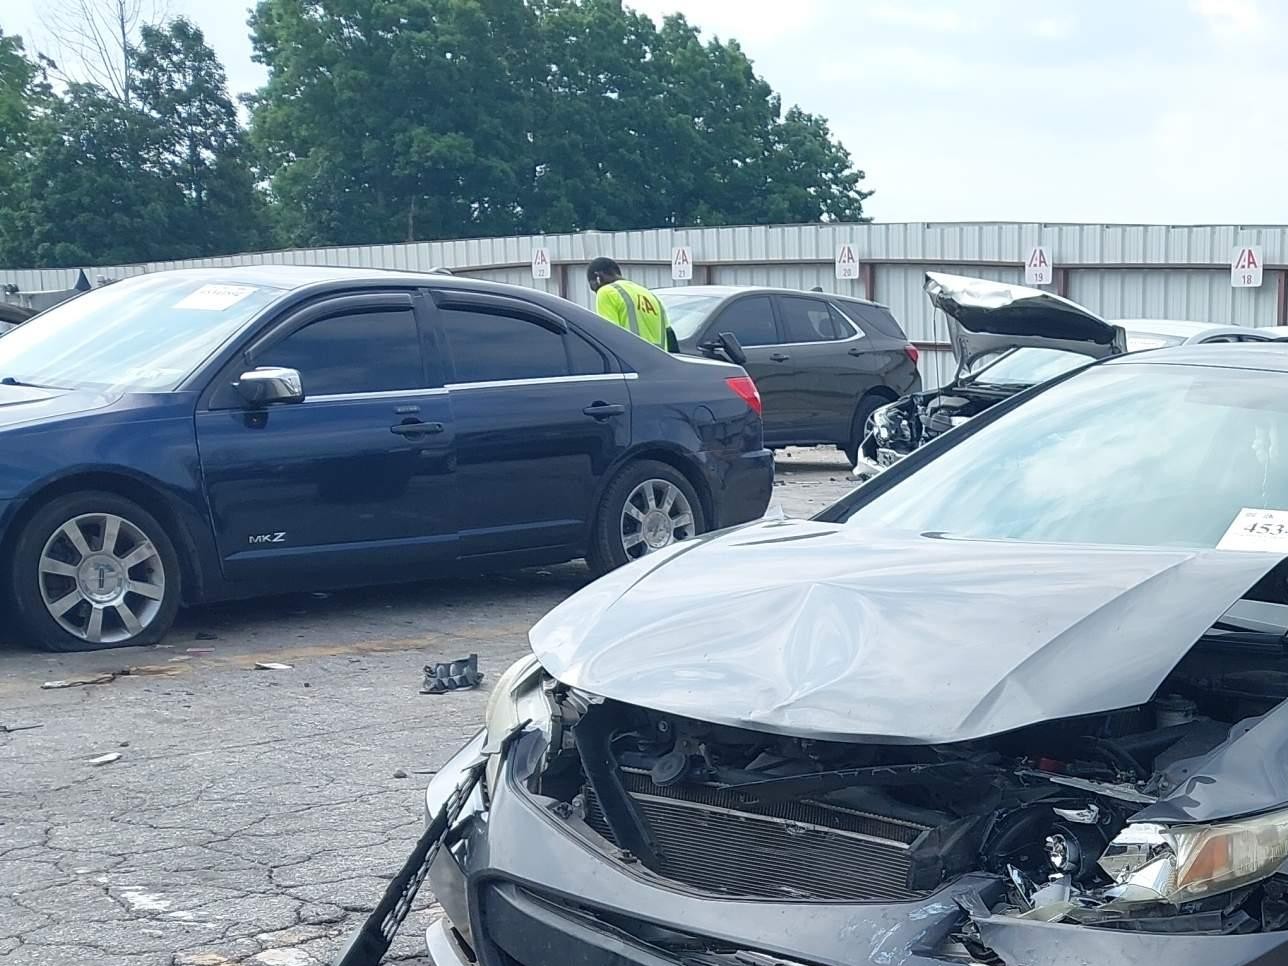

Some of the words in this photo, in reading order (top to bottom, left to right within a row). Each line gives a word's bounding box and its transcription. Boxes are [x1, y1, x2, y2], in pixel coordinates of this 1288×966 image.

[1034, 273, 1043, 282] 19
[1242, 274, 1252, 285] 18
[248, 532, 287, 544] MKZ
